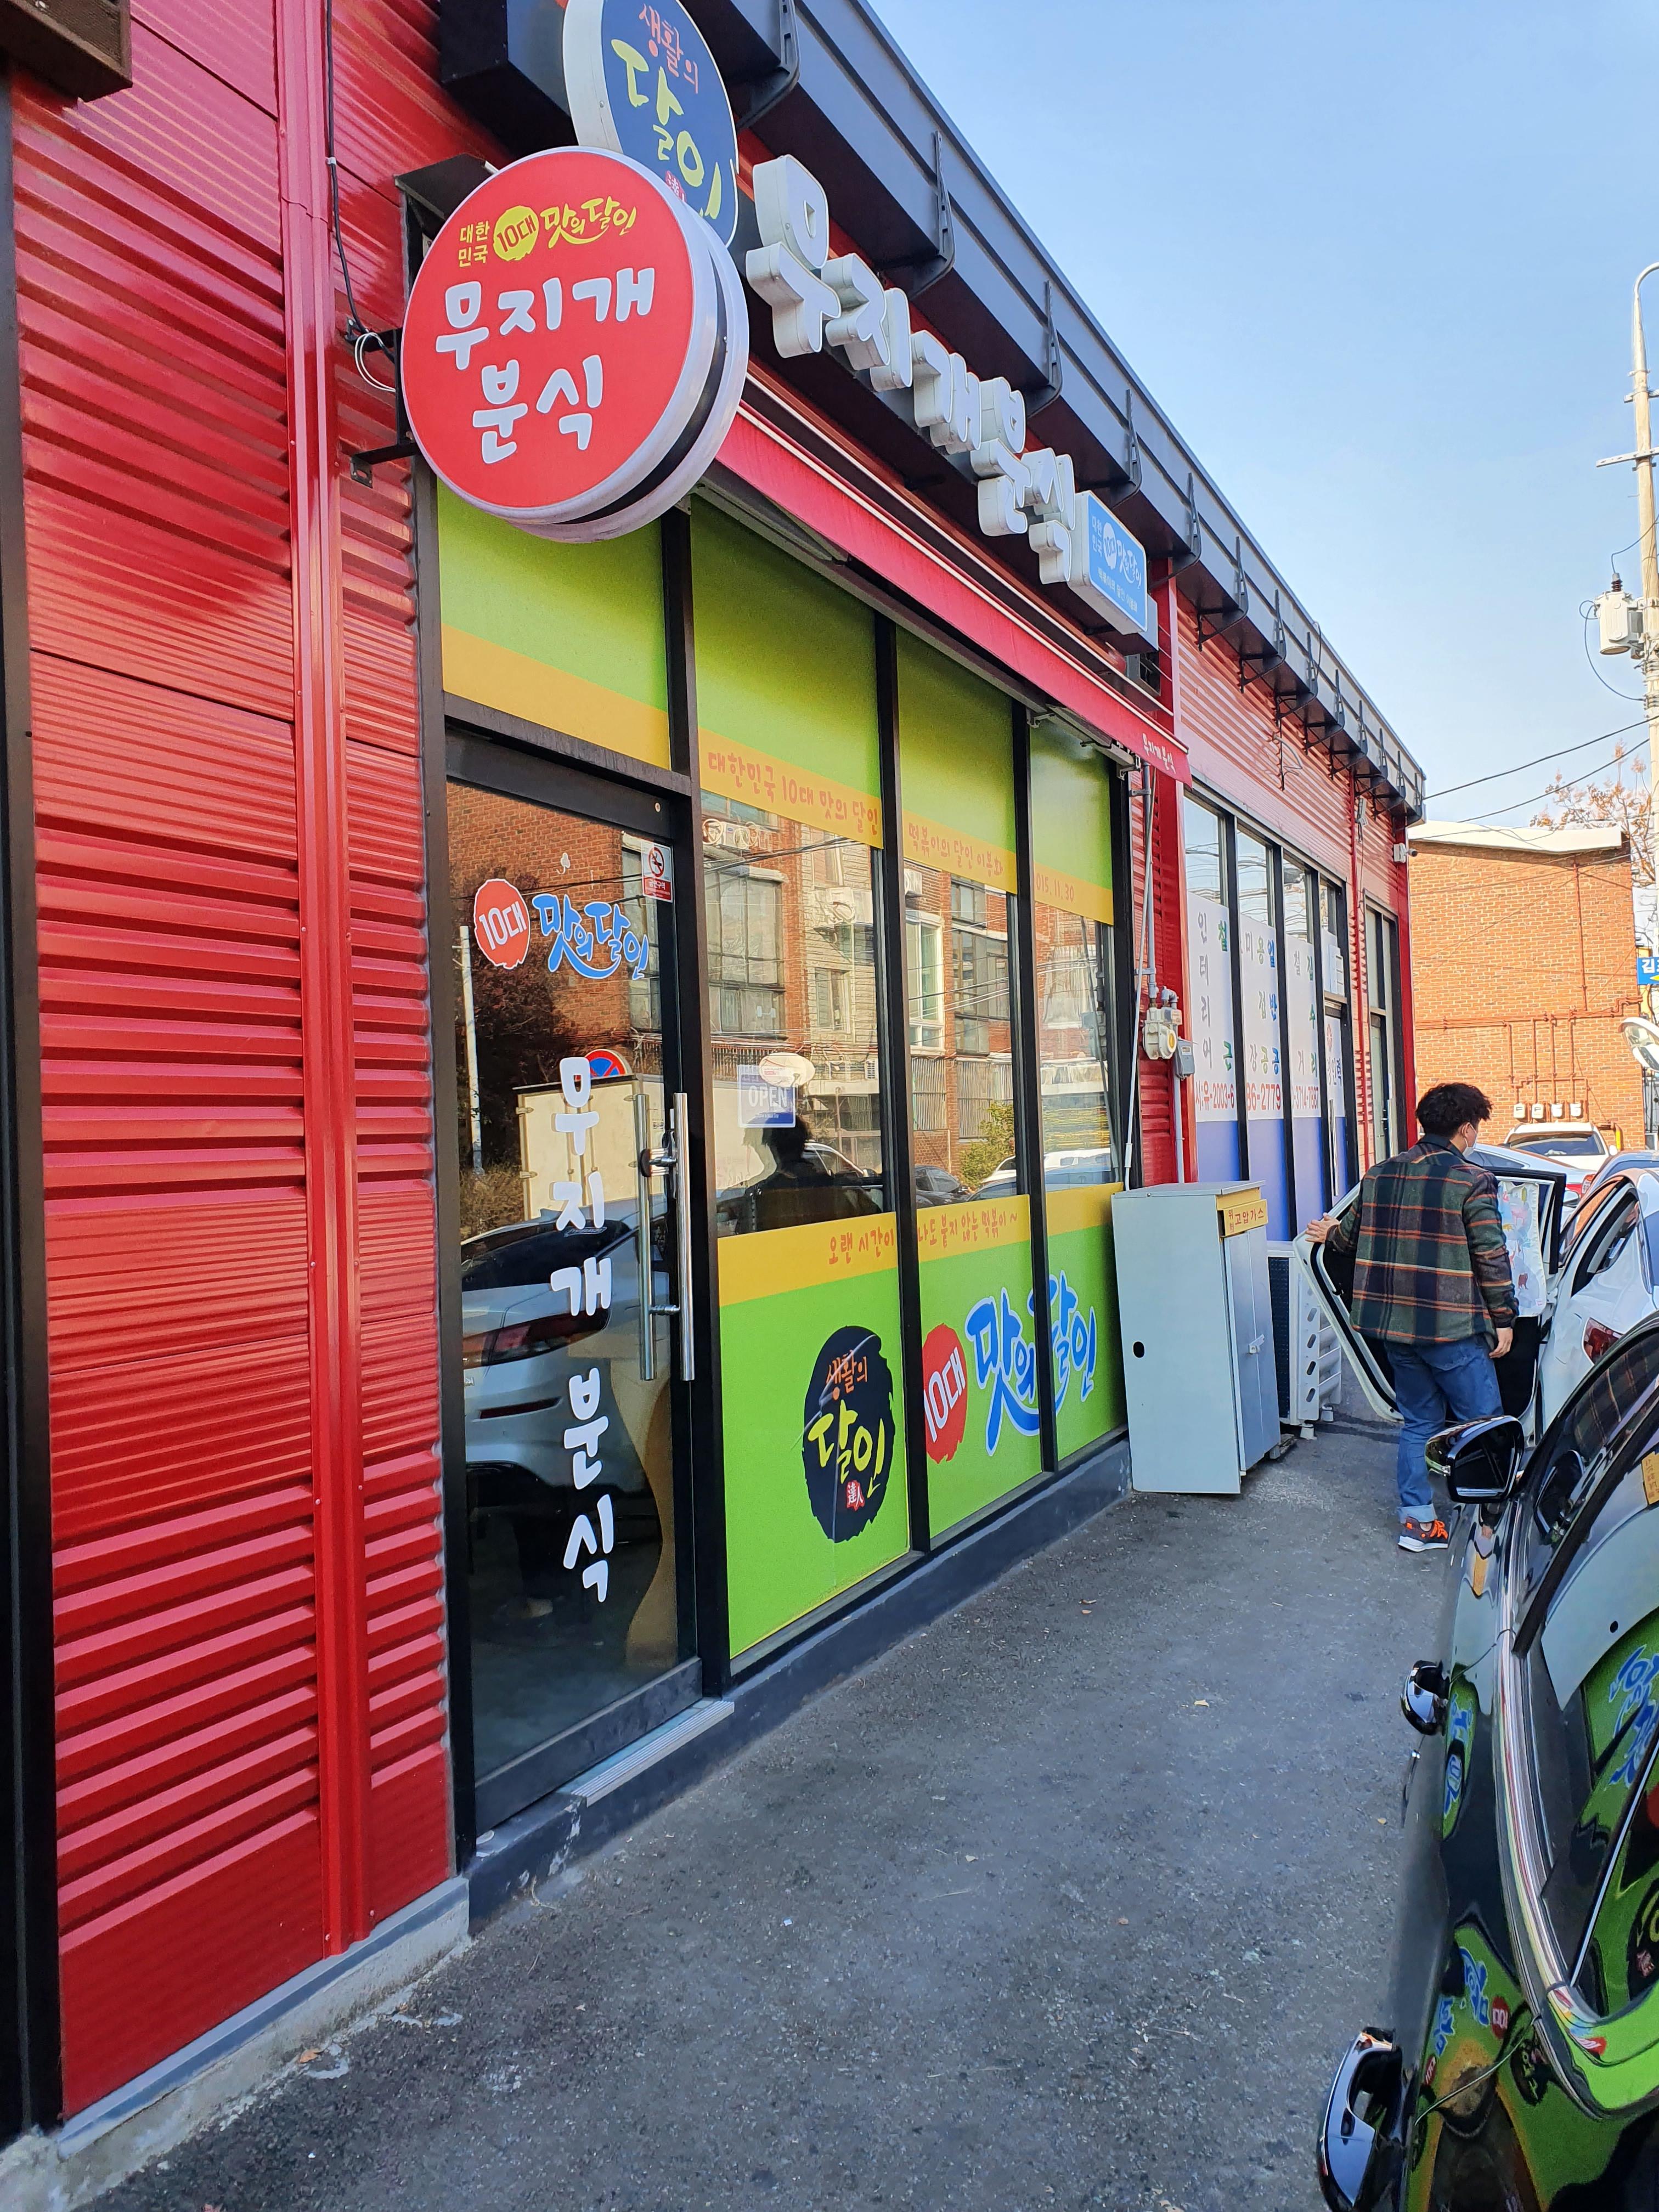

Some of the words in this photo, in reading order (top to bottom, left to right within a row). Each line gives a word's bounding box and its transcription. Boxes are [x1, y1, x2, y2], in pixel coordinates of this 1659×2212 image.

[638, 3, 698, 94] 생활의
[611, 38, 722, 219] 달인
[458, 244, 489, 268] 민국
[459, 221, 490, 243] 대한
[496, 215, 537, 252] 10대
[540, 202, 586, 249] 맛의
[580, 195, 637, 236] 달인
[436, 267, 656, 371] 무지개
[472, 354, 603, 465] 분식
[708, 752, 776, 804] 대한민국
[782, 775, 814, 805] 10대
[820, 791, 848, 821] 맛의
[852, 801, 878, 836] 달인
[909, 822, 950, 858] 떡볶이의
[954, 839, 973, 870] 달인
[479, 901, 527, 950] 10대
[532, 893, 594, 980] 맛의
[584, 901, 650, 980] 달인
[1641, 958, 1659, 974] 김
[1198, 911, 1212, 1069] 인테리어
[748, 1085, 788, 1108] OPEN
[551, 1056, 613, 1316] 무지개
[1234, 1207, 1264, 1226] 고압가스
[829, 1232, 853, 1265] 오랜
[859, 1226, 894, 1258] 시간이
[918, 1218, 937, 1246] 나도
[961, 1211, 979, 1242] 않는
[826, 1349, 868, 1401] 생활의
[924, 1347, 966, 1443] 10대
[563, 1367, 615, 1604] 분식
[808, 1399, 885, 1499] 달인
